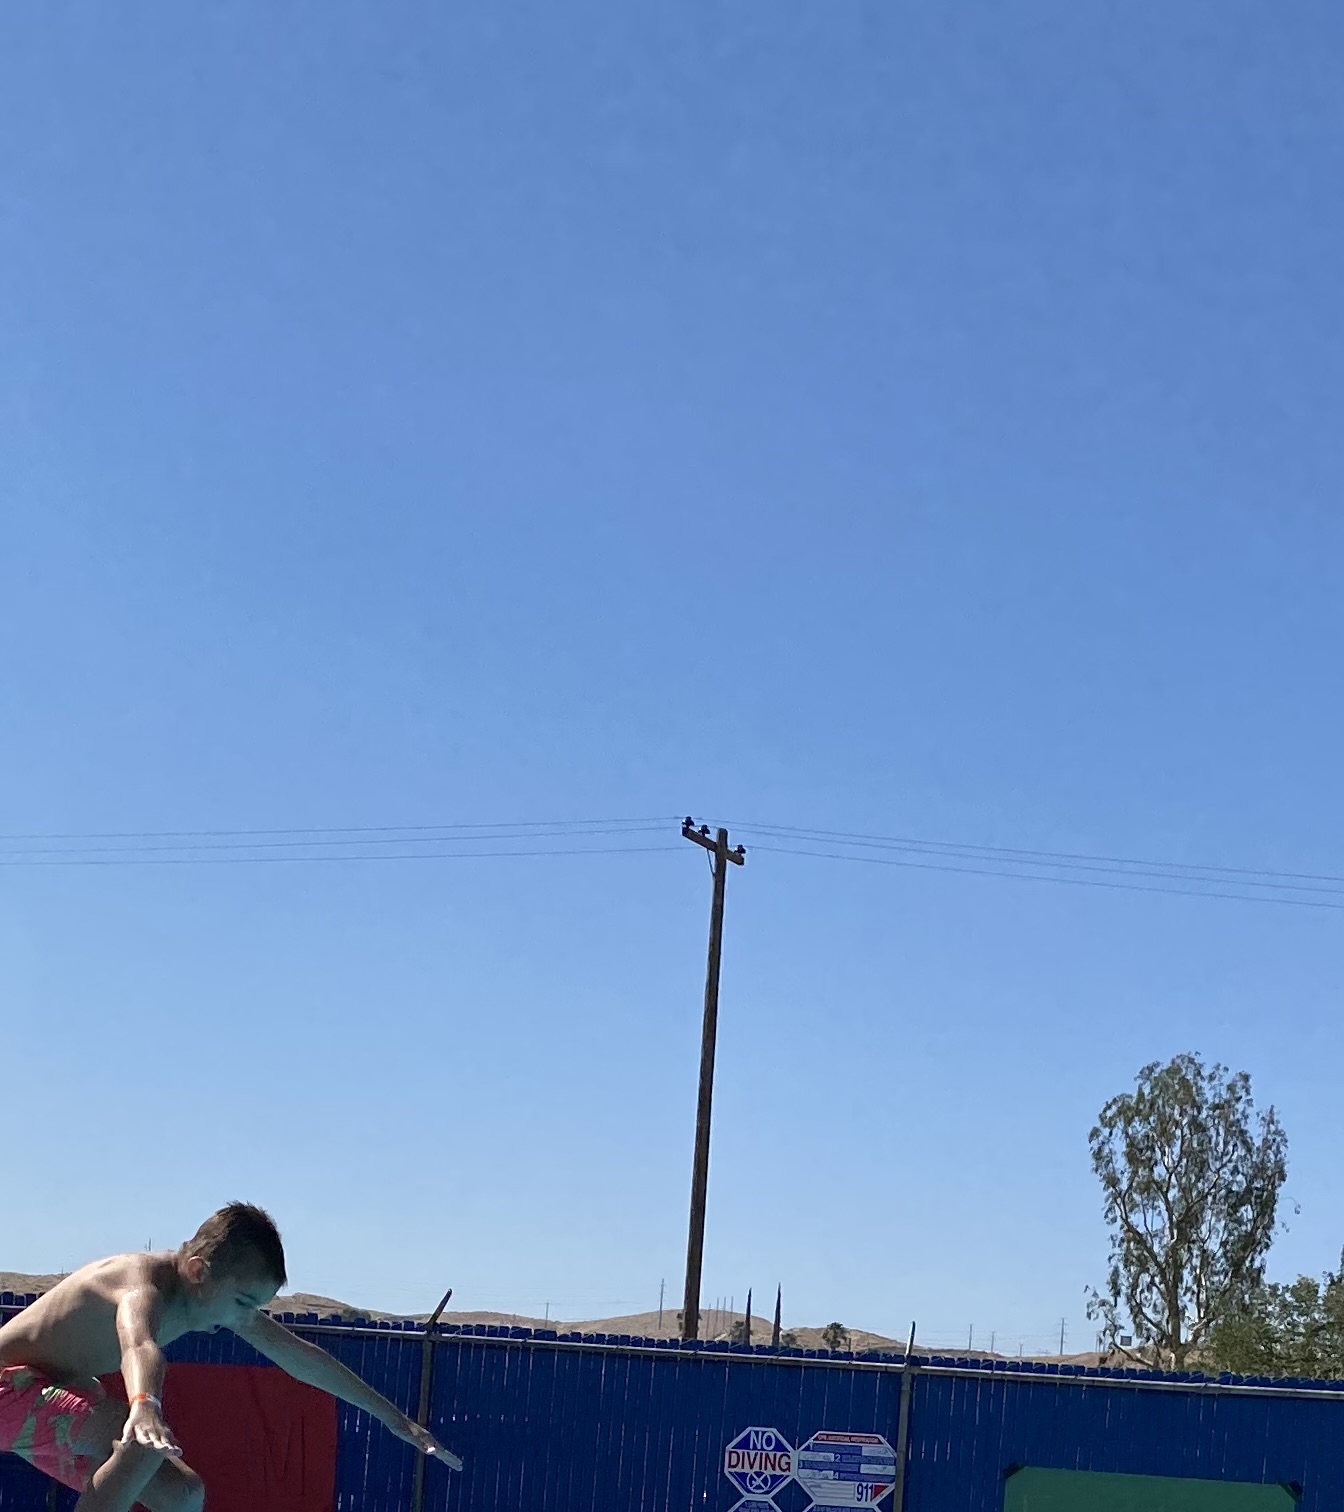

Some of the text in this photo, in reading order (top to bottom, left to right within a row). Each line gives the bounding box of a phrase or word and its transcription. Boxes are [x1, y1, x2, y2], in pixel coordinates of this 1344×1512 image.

[750, 1430, 777, 1451] NO
[727, 1451, 792, 1474] DIVING
[856, 1482, 874, 1502] 911
